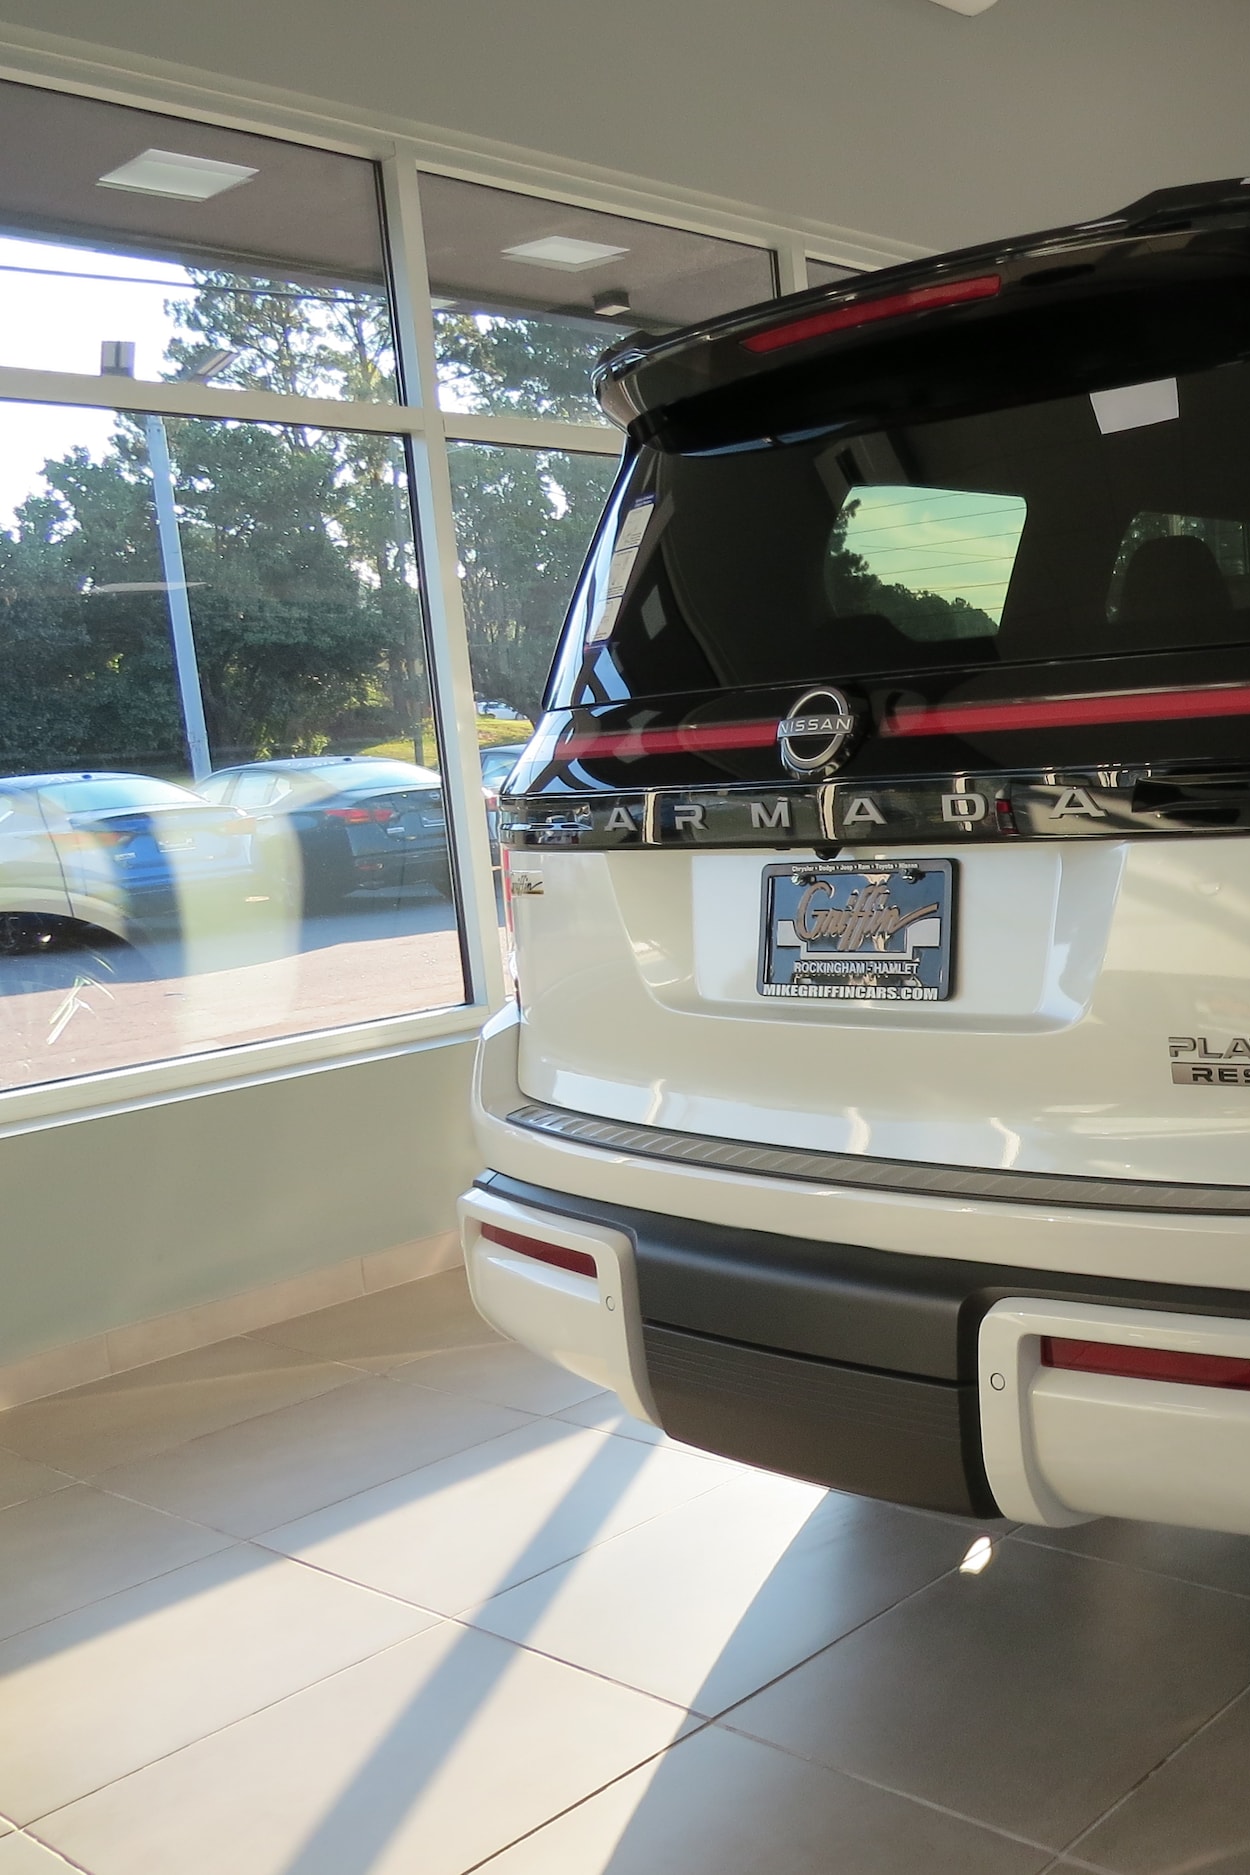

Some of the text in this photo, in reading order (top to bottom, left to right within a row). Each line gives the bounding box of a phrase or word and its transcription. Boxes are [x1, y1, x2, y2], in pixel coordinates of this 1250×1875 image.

[780, 717, 852, 734] NISSAN
[603, 785, 1108, 833] ARMADA
[796, 880, 939, 951] Griffin
[763, 983, 939, 1001] MIKEGRIFFINCARS.COM
